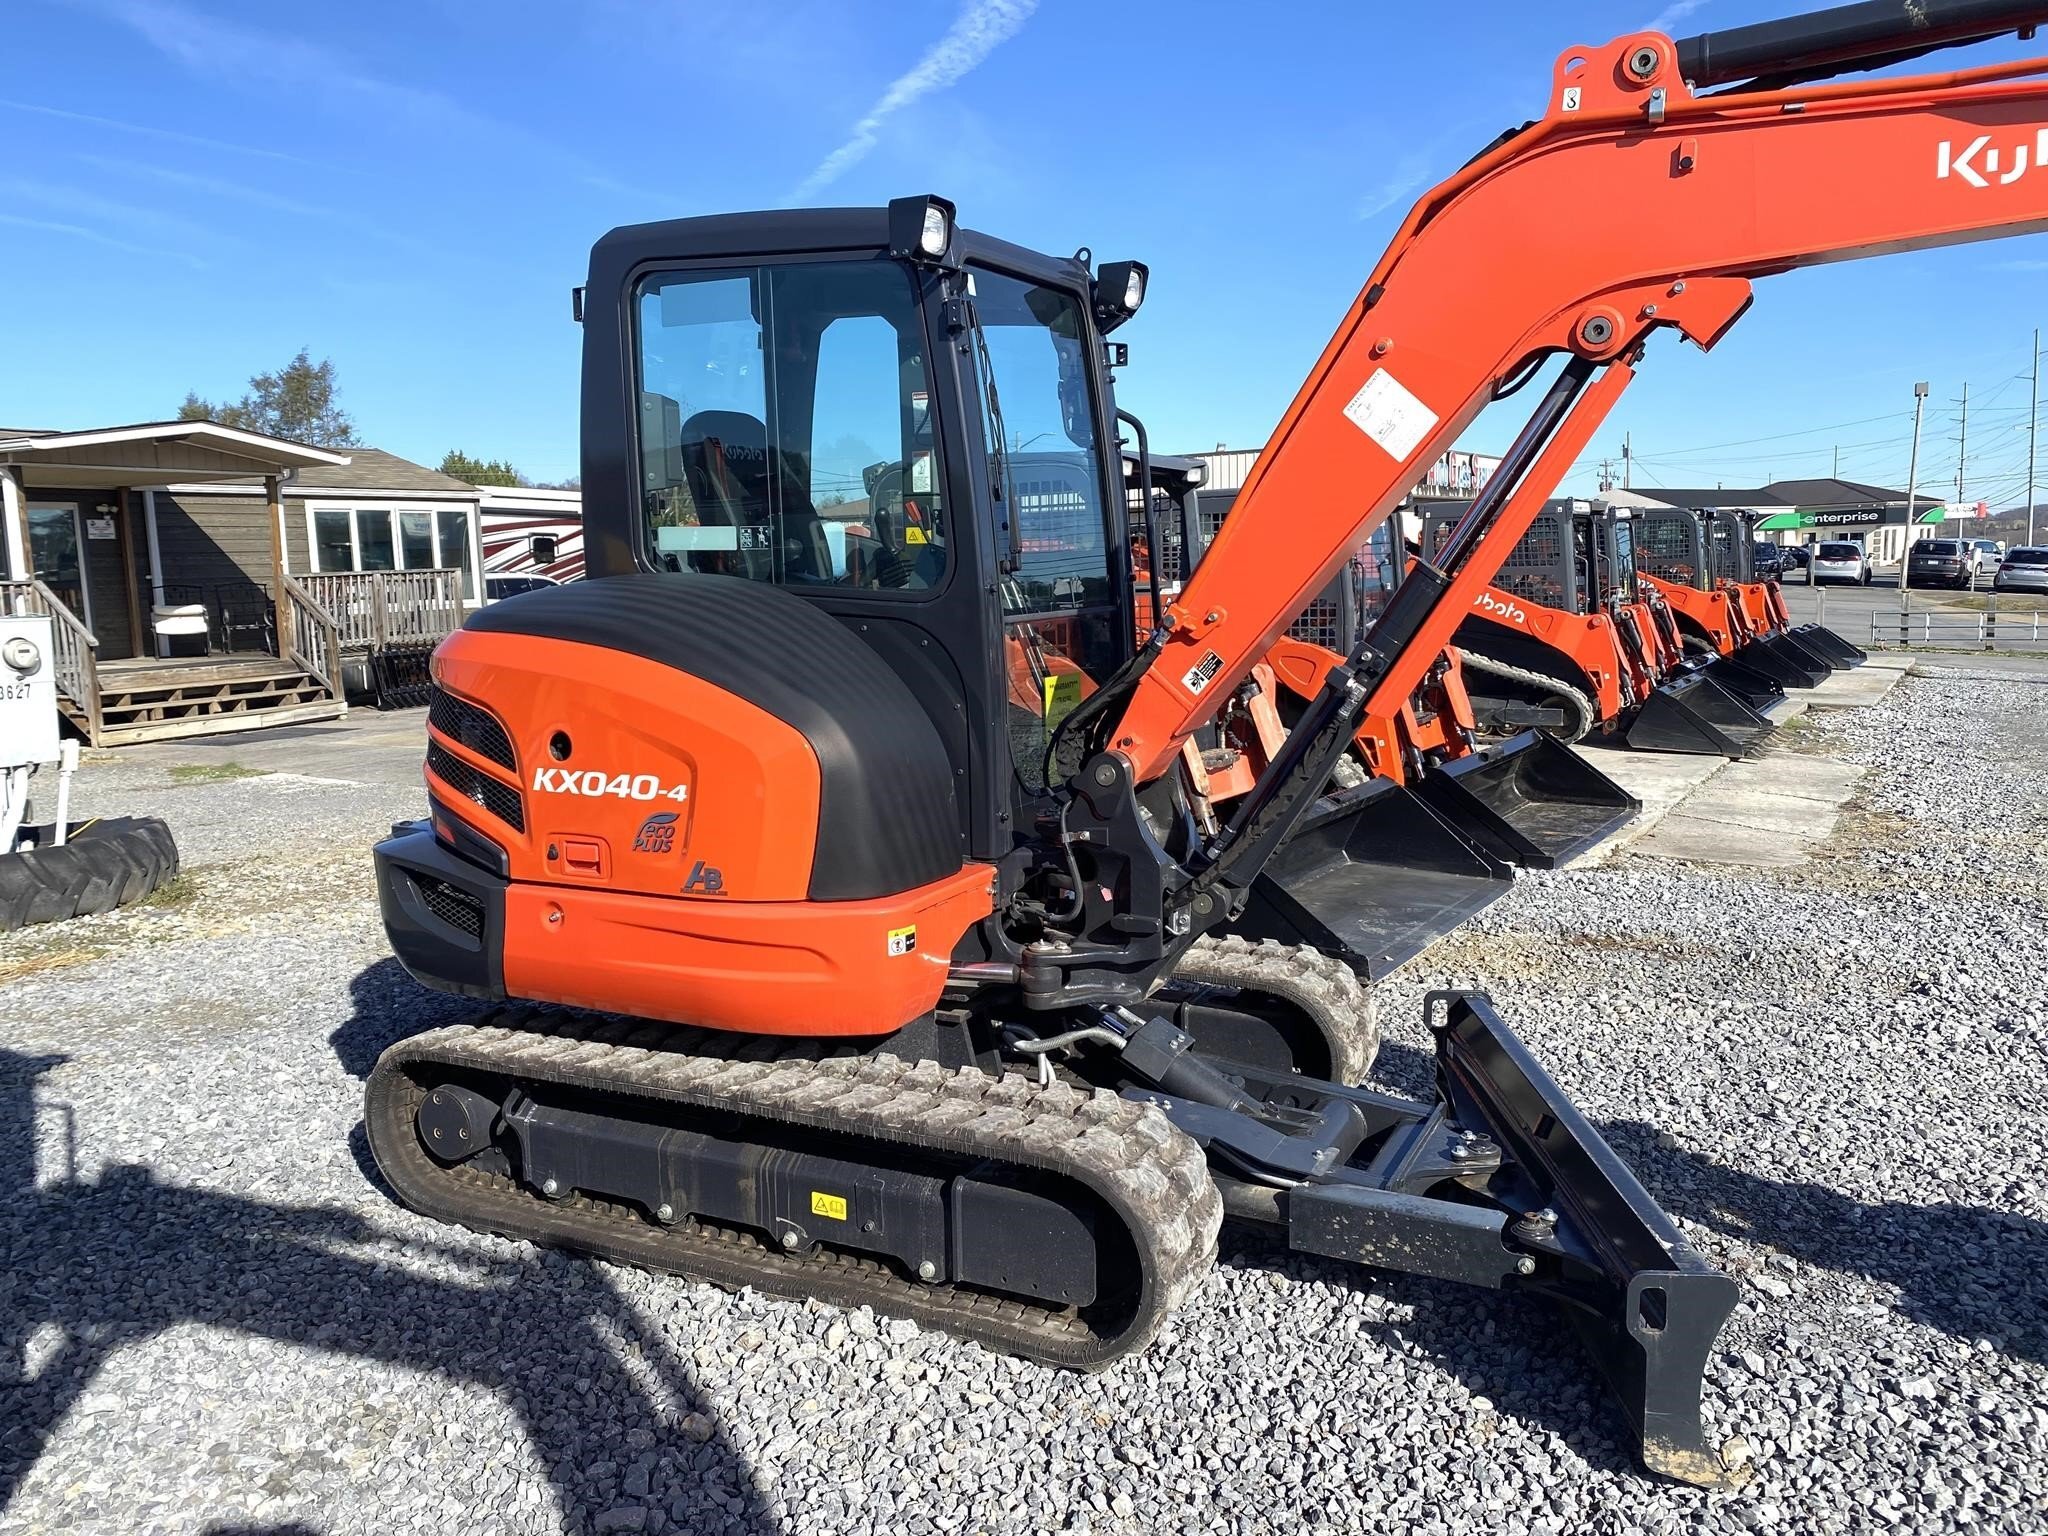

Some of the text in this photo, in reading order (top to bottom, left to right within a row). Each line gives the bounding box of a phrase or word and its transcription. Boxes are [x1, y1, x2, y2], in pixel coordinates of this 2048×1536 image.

[1803, 511, 1879, 525] enterprise
[1473, 592, 1525, 624] ubota
[532, 767, 688, 802] KX040-4
[645, 825, 676, 839] eco
[632, 837, 674, 854] PLUS
